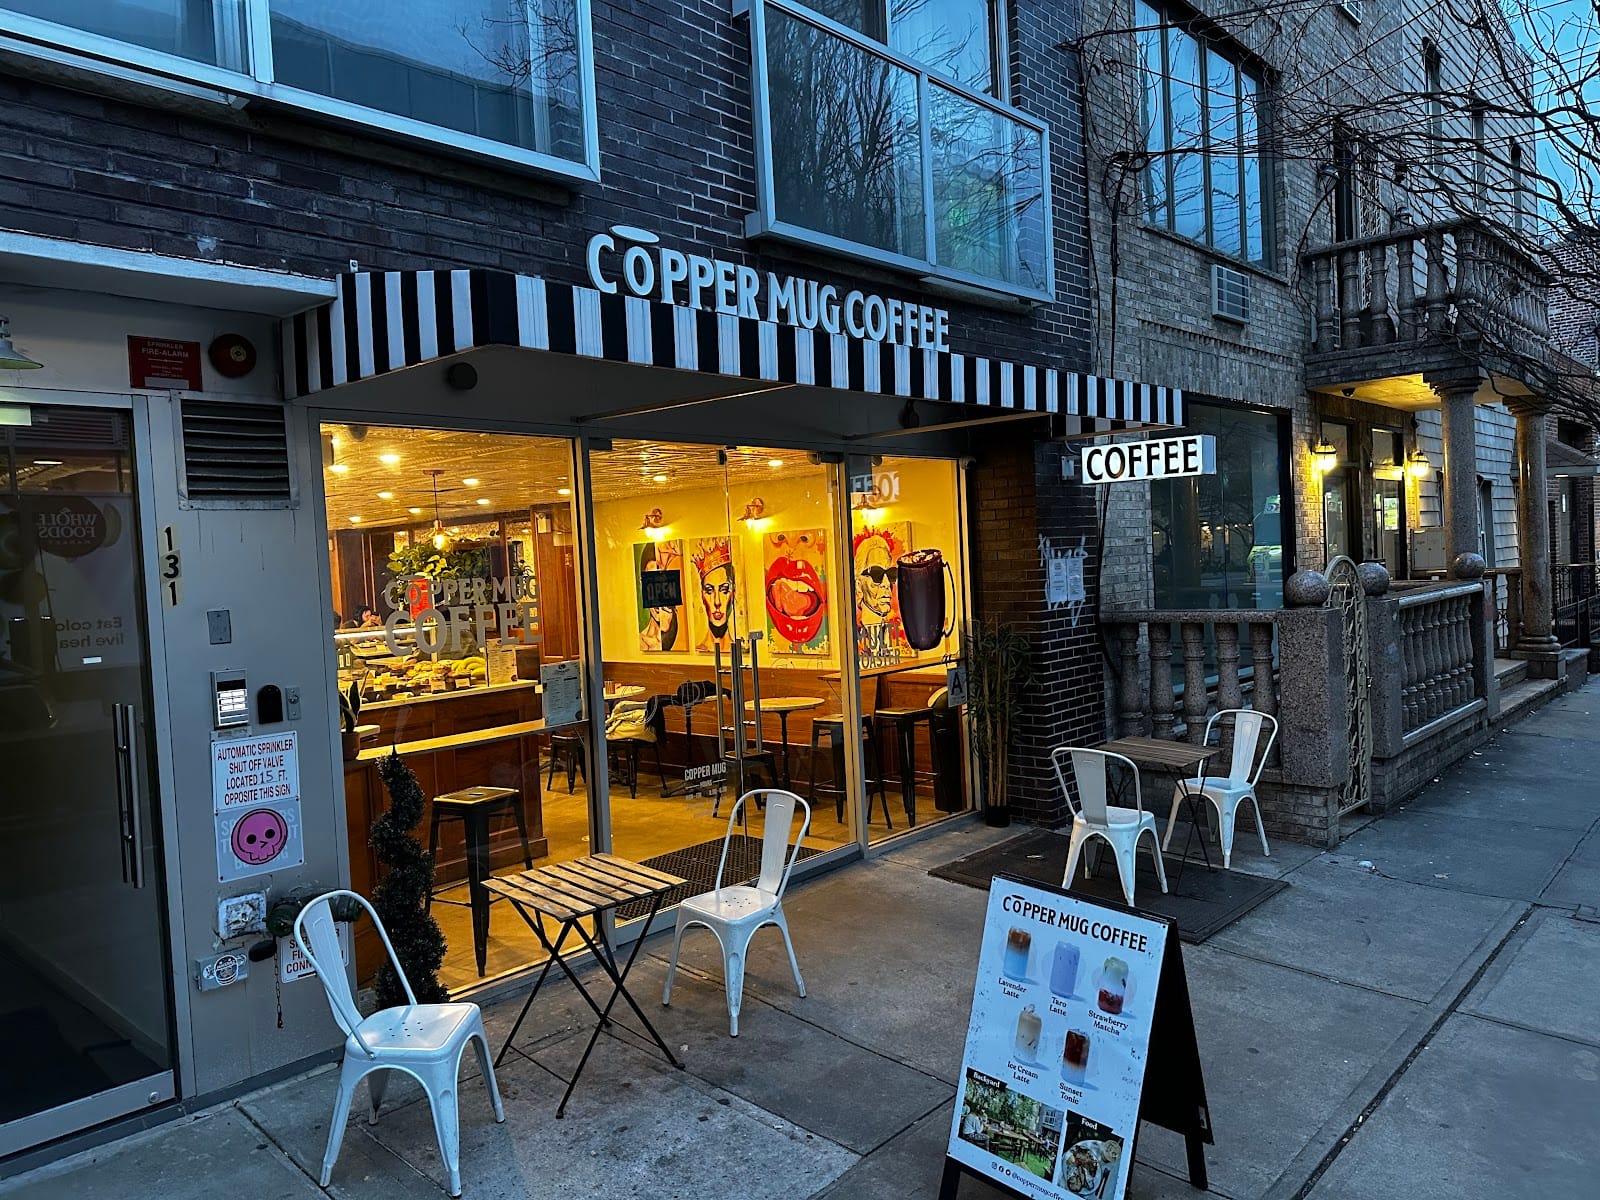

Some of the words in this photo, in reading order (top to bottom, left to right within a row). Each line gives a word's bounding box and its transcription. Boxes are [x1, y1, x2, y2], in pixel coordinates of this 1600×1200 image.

[586, 225, 760, 321] COPPER
[767, 271, 841, 334] MUG
[844, 290, 950, 353] COFFEE
[141, 347, 189, 358] FIRE-ALARM
[147, 341, 184, 350] SPRINKLER
[1086, 438, 1199, 481] COFFEE
[163, 526, 179, 607] 131
[384, 575, 487, 610] COPPER
[492, 575, 540, 603] MUG
[646, 581, 678, 601] OPEN
[385, 602, 543, 657] COFFEE
[951, 671, 963, 696] A
[217, 743, 257, 761] AUTOMATIC
[258, 738, 294, 754] SPRINKLER
[229, 760, 248, 775] SHUT
[249, 759, 262, 771] OFF
[262, 755, 284, 769] VALVE
[684, 764, 711, 781] COPPER
[711, 762, 727, 776] MUG
[226, 774, 258, 790] LOCATED
[260, 769, 274, 784] 15
[278, 769, 288, 781] FT.
[224, 790, 258, 806] OPPOSITE
[259, 786, 274, 799] THIS
[275, 783, 291, 796] SIGN
[1002, 894, 1057, 926] COPPER
[1057, 912, 1089, 936] MUG
[1091, 922, 1148, 953] COFFEE
[998, 977, 1027, 993] Lavender
[1003, 987, 1020, 999] Latte
[1049, 1005, 1067, 1017] Latte
[1051, 996, 1067, 1008] Taro
[1088, 1009, 1129, 1031] Strawberry
[1093, 1021, 1120, 1037] Matcha
[973, 1071, 1001, 1089] Backyard
[1007, 1061, 1017, 1071] Ice
[1017, 1063, 1039, 1080] Cream
[1013, 1072, 1030, 1085] Latte
[1059, 1082, 1083, 1098] Sunset
[1060, 1091, 1080, 1105] Tonic
[1081, 1117, 1098, 1131] Food
